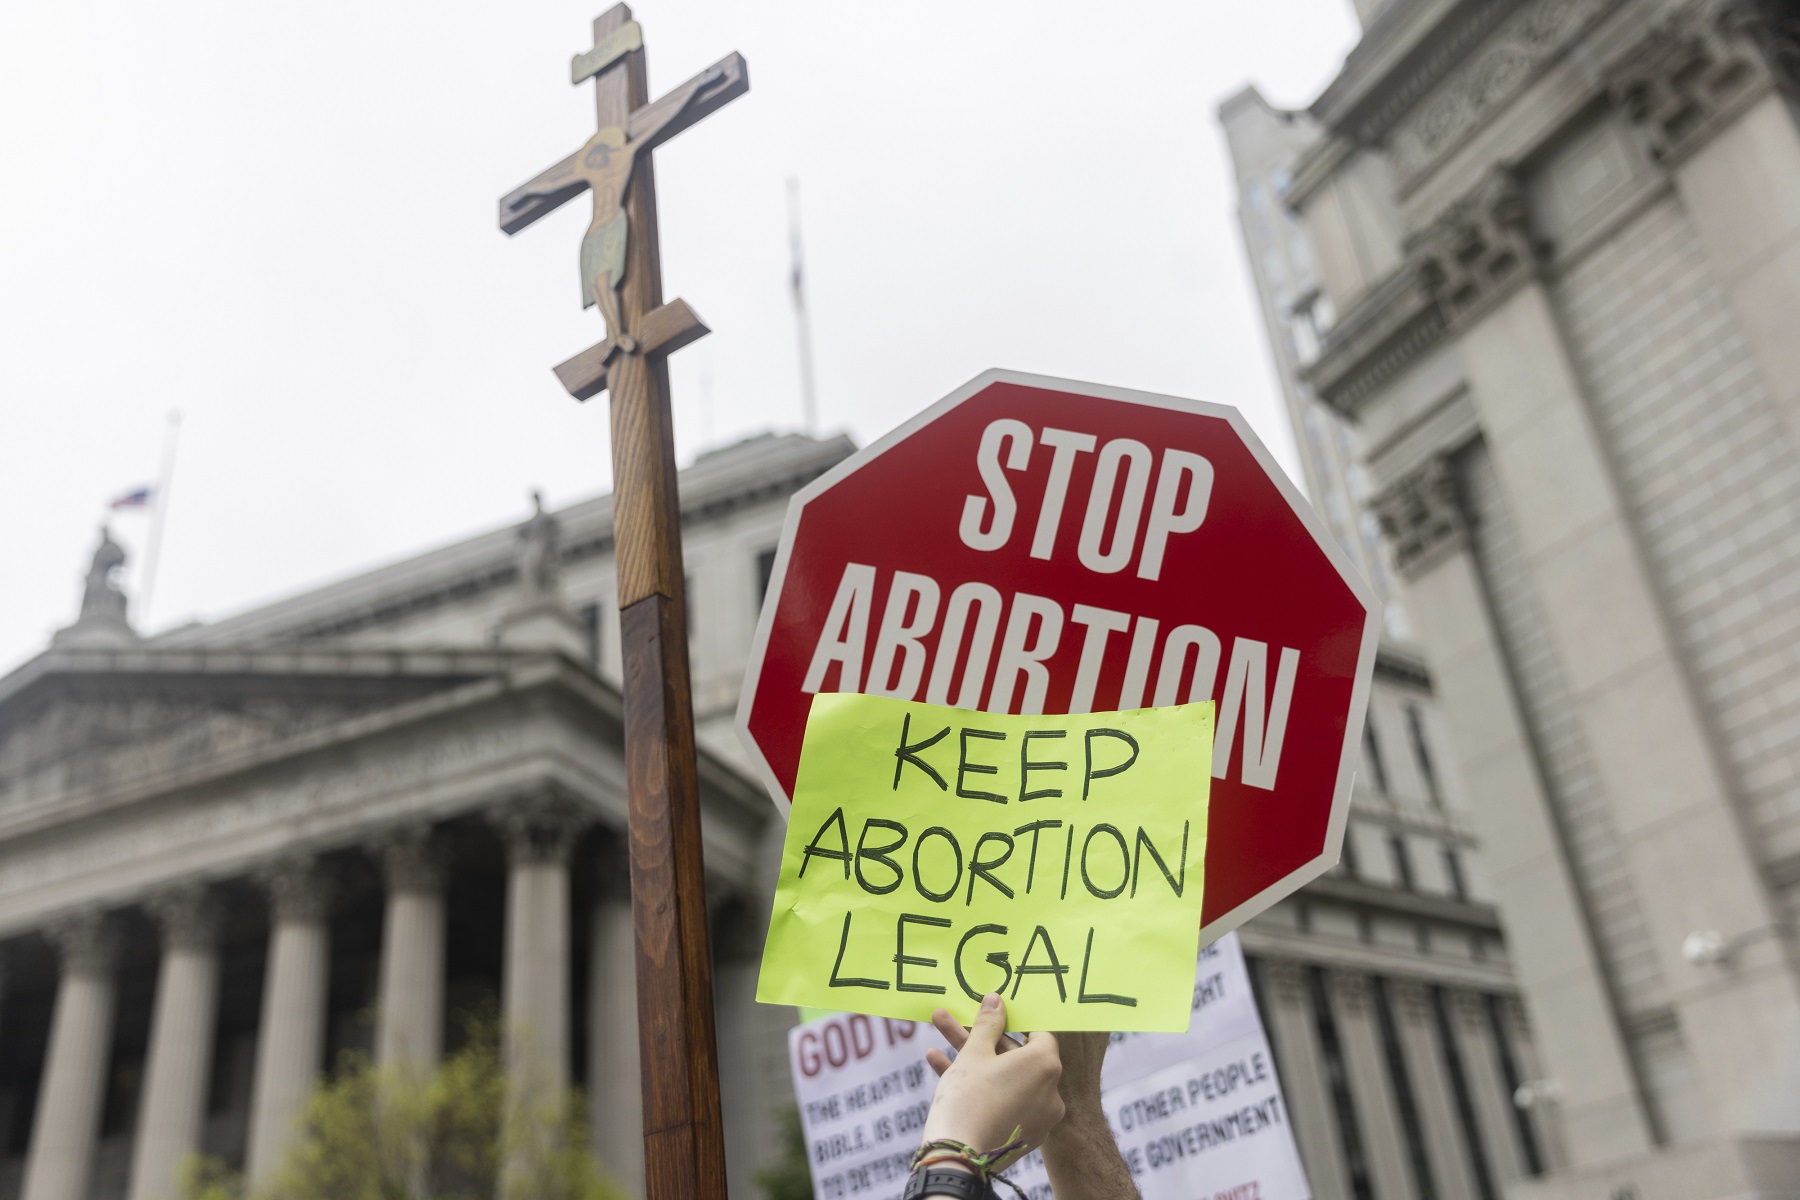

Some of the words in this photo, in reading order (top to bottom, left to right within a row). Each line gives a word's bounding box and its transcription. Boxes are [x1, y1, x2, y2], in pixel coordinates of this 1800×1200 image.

[959, 418, 1214, 582] STOP
[801, 562, 1300, 791] ABORTION
[893, 712, 1140, 804] KEEP
[798, 806, 1190, 906] ABORTION
[828, 910, 1138, 1007] LEGAL
[798, 1014, 874, 1078] GOD
[1118, 1085, 1186, 1132] OTHER
[1186, 1052, 1268, 1107] PEOPLE
[1145, 1095, 1283, 1169] GOVERNMENT
